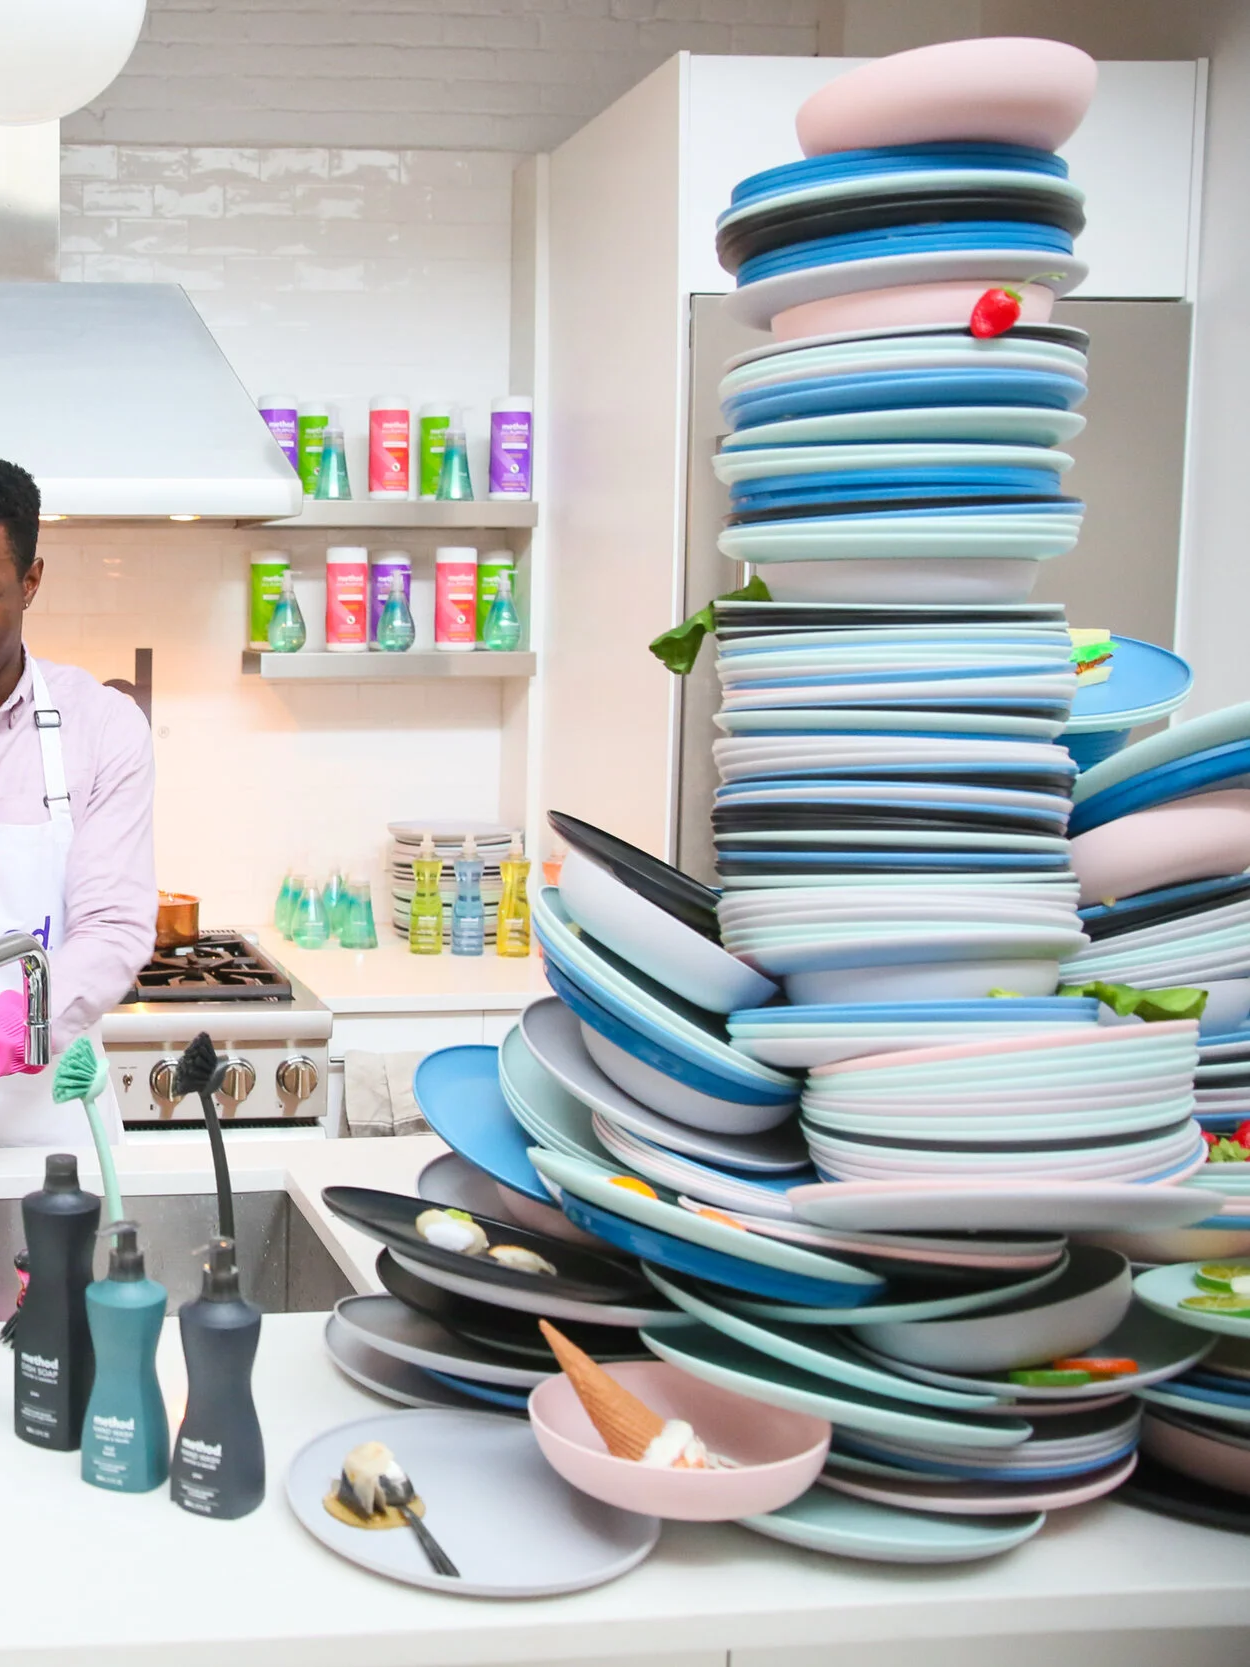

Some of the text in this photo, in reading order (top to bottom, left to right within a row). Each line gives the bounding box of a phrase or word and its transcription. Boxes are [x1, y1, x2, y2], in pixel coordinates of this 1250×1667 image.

[501, 423, 528, 431] method
[21, 1352, 59, 1370] method
[37, 1367, 59, 1379] SOAP
[93, 1415, 135, 1431] method
[181, 1437, 222, 1458] method
